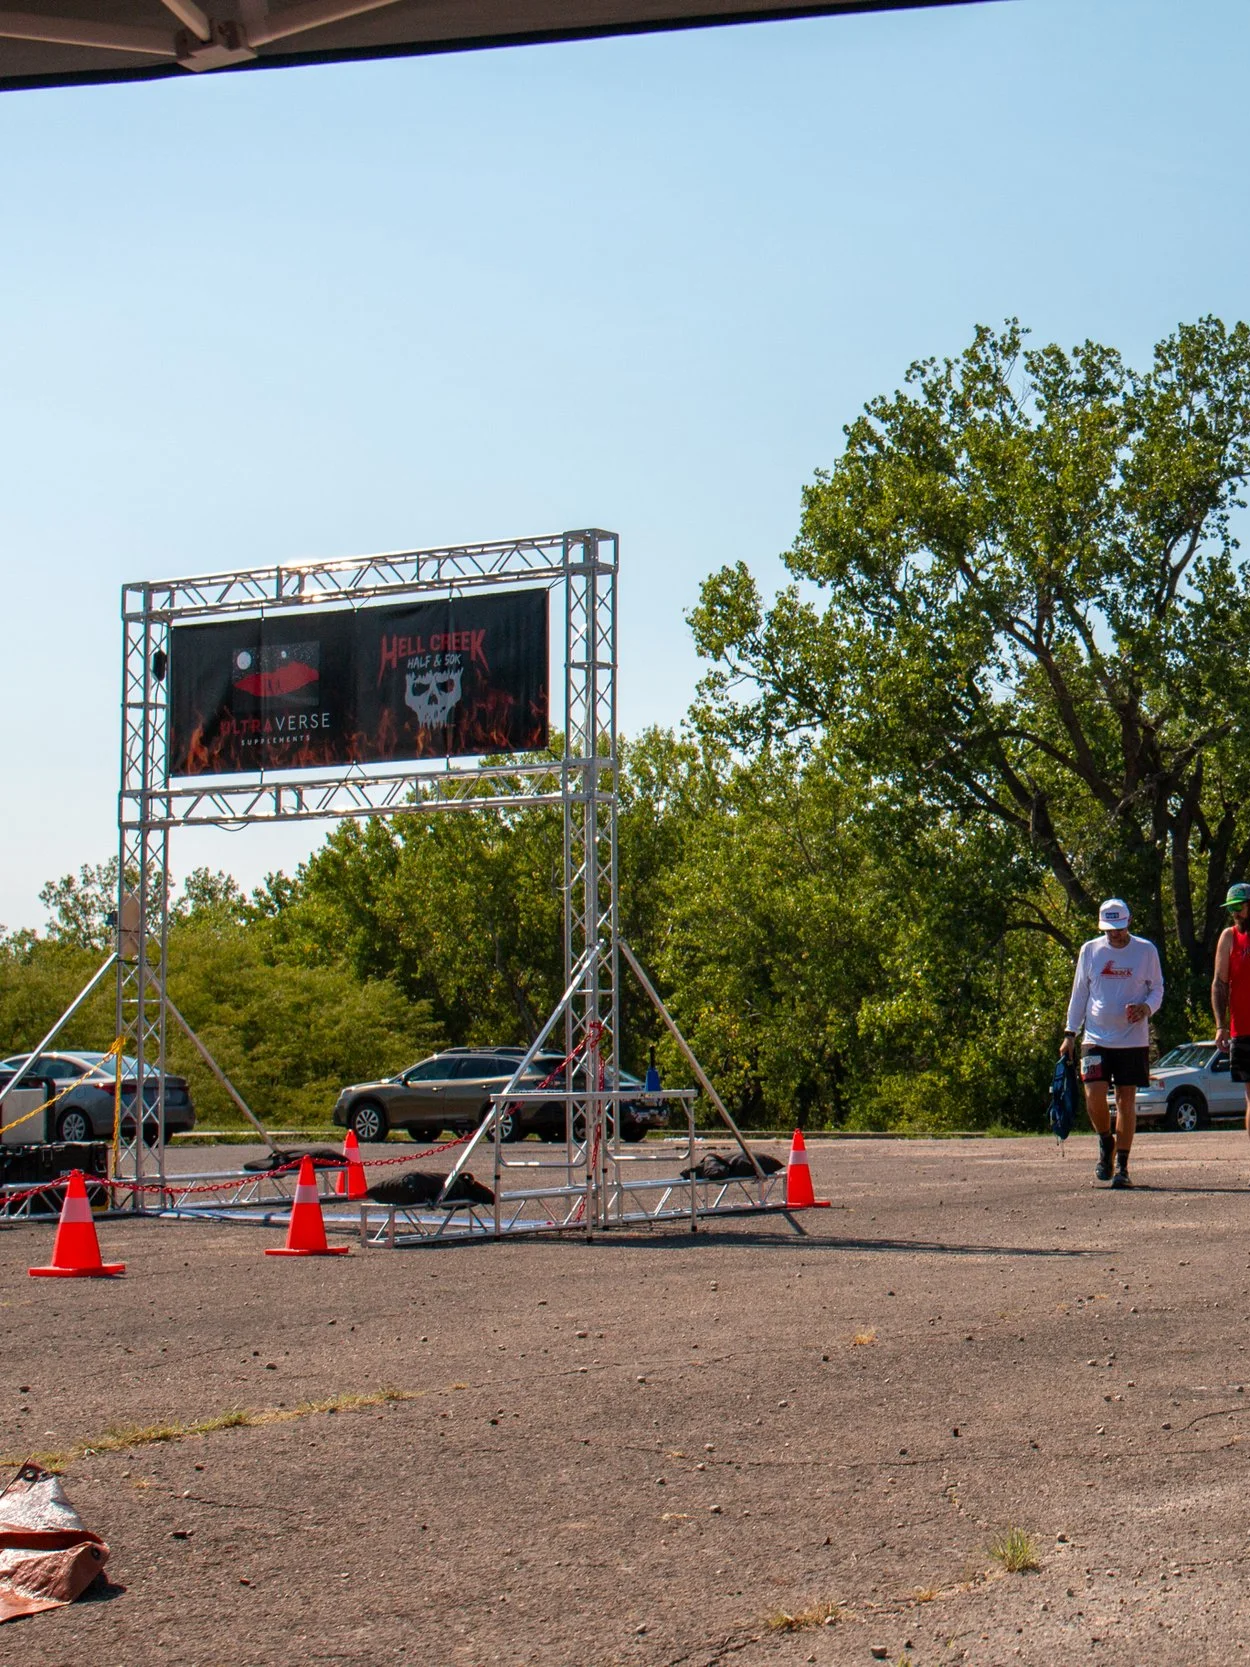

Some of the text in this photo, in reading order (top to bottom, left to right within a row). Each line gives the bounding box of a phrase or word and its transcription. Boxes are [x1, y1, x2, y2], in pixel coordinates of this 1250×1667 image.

[378, 628, 490, 688] HELL CREEK
[407, 653, 461, 669] HALF & 50K
[219, 712, 331, 736] ULTRAVERSE
[241, 734, 311, 746] SUPPLEMENTS
